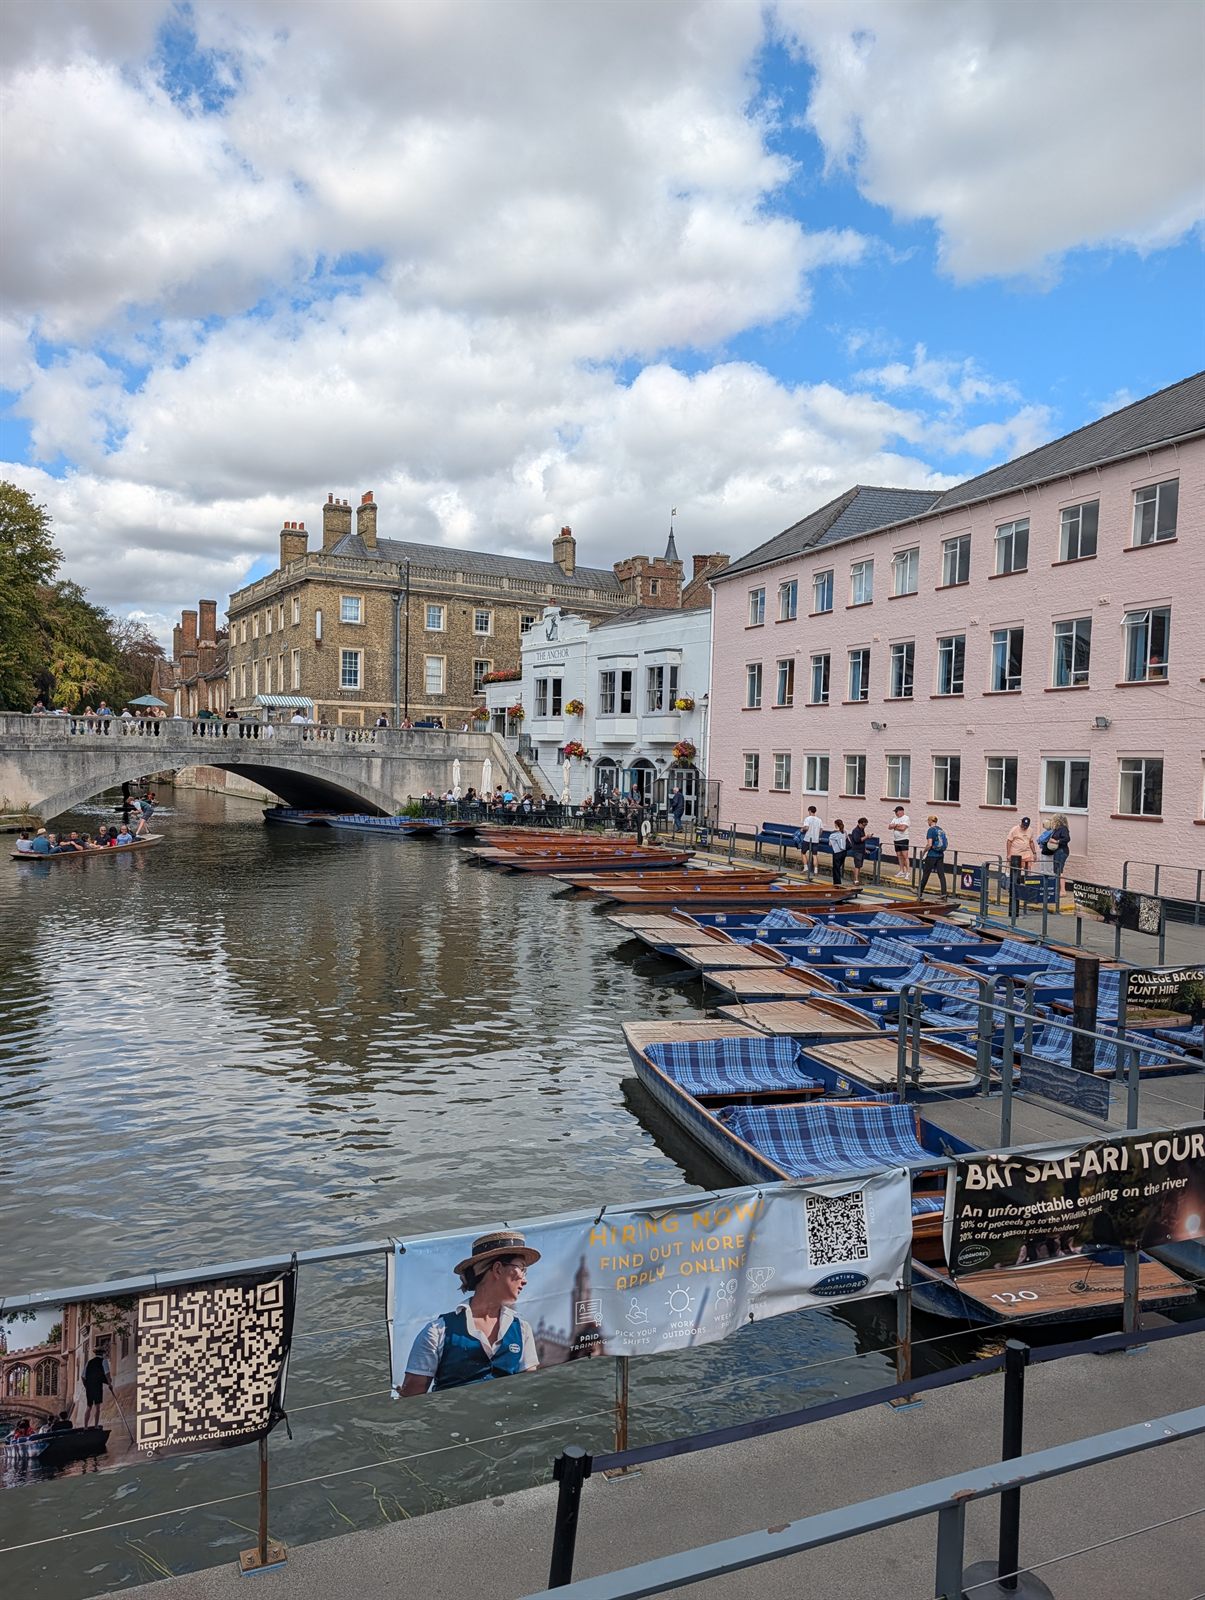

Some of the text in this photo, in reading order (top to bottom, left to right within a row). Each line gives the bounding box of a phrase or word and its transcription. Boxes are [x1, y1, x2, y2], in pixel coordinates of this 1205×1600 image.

[536, 648, 570, 661] THE ANCHOR
[1129, 971, 1204, 984] COLLEGE BACKS
[1127, 984, 1180, 995] PUNT HIRE
[964, 1133, 1205, 1190] BAT SAFARI TOUR
[961, 1176, 1189, 1219] An unforgettable evening on the river
[960, 1205, 1103, 1231] 50% of proceeds go to the Wildlife Trust
[588, 1213, 680, 1248] HIRING
[959, 1223, 1080, 1242] 20% off for season ticket holders
[600, 1253, 644, 1271] FIND
[650, 1242, 683, 1262] OUT
[690, 1234, 745, 1254] MORE
[616, 1265, 666, 1291] APPLY
[827, 1274, 855, 1283] PUNTING
[991, 1290, 1039, 1303] 120
[670, 1319, 695, 1329] WORK
[580, 1333, 600, 1342] PAID
[615, 1327, 657, 1338] PICK YOUR
[662, 1326, 706, 1340] OUTDOORS
[570, 1338, 608, 1352] TRAINING
[623, 1337, 650, 1345] SHIFTS
[137, 1422, 269, 1451] https://www.scudamores.co
